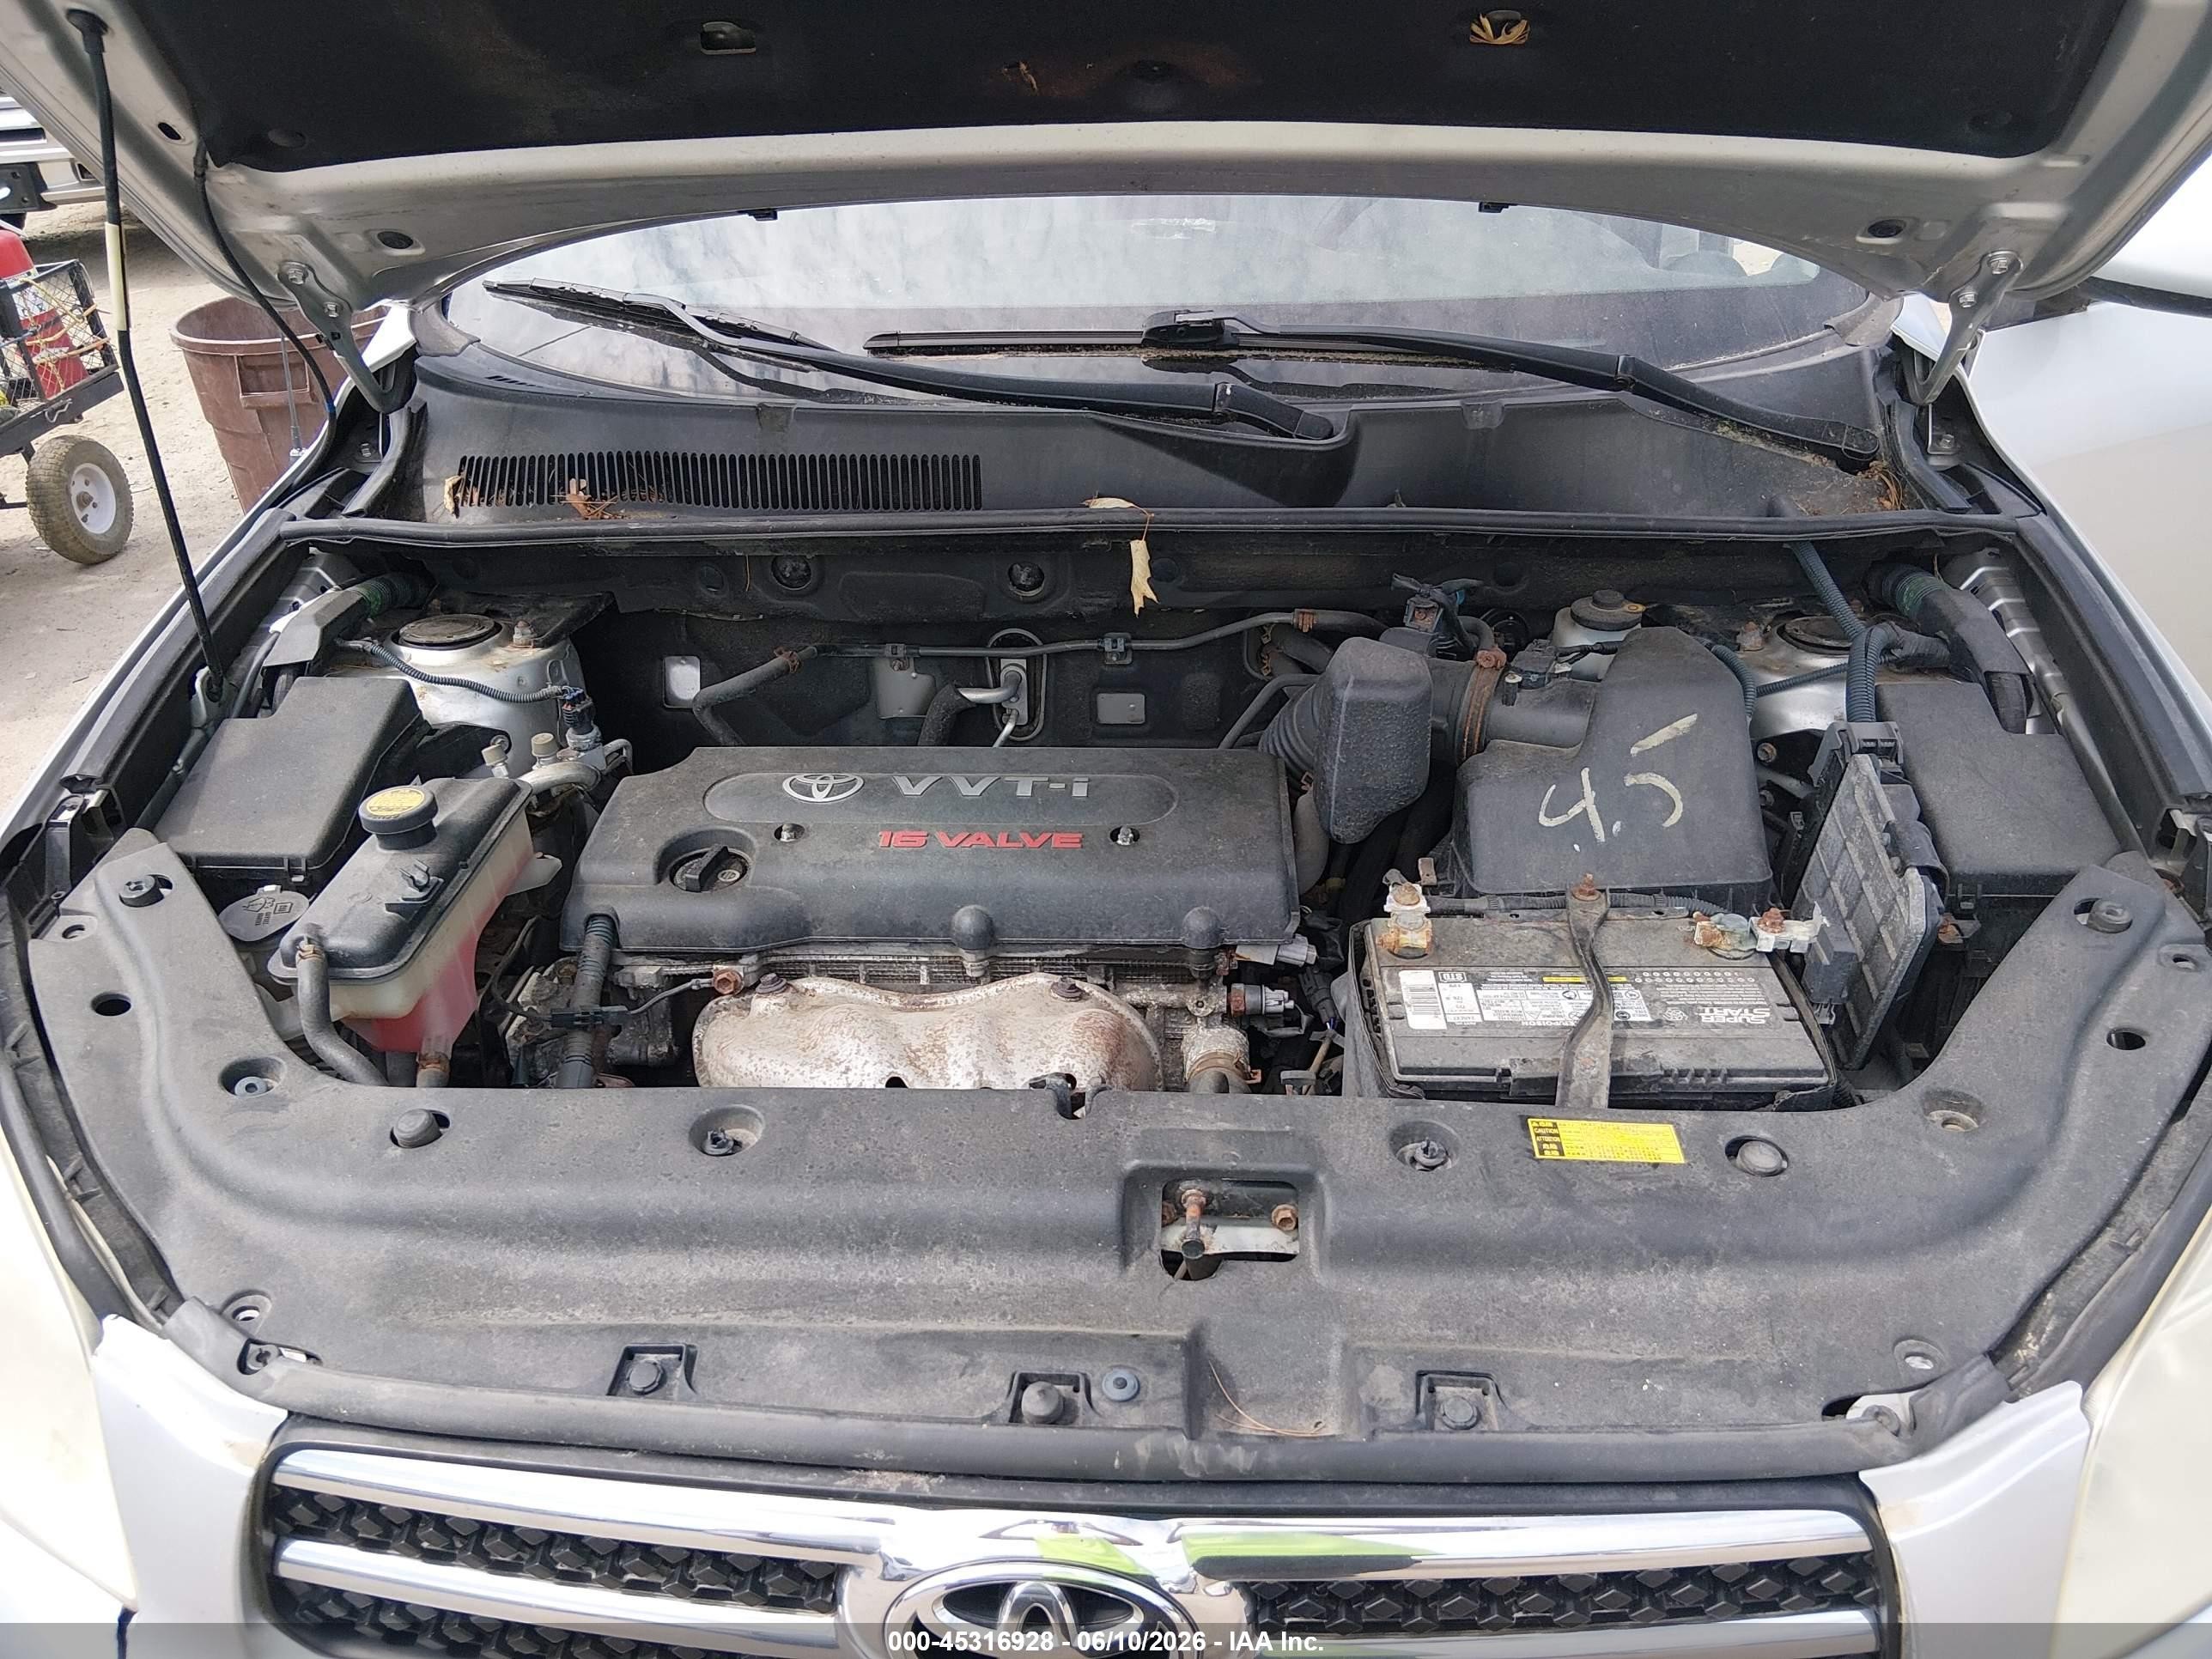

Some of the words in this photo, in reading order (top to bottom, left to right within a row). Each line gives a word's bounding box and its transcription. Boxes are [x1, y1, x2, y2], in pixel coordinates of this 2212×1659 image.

[893, 775, 1091, 798] VVT-i
[879, 830, 929, 848] 16
[936, 831, 1085, 849] VALVE
[1697, 1007, 1771, 1018] START
[1701, 1015, 1766, 1024] SUPER
